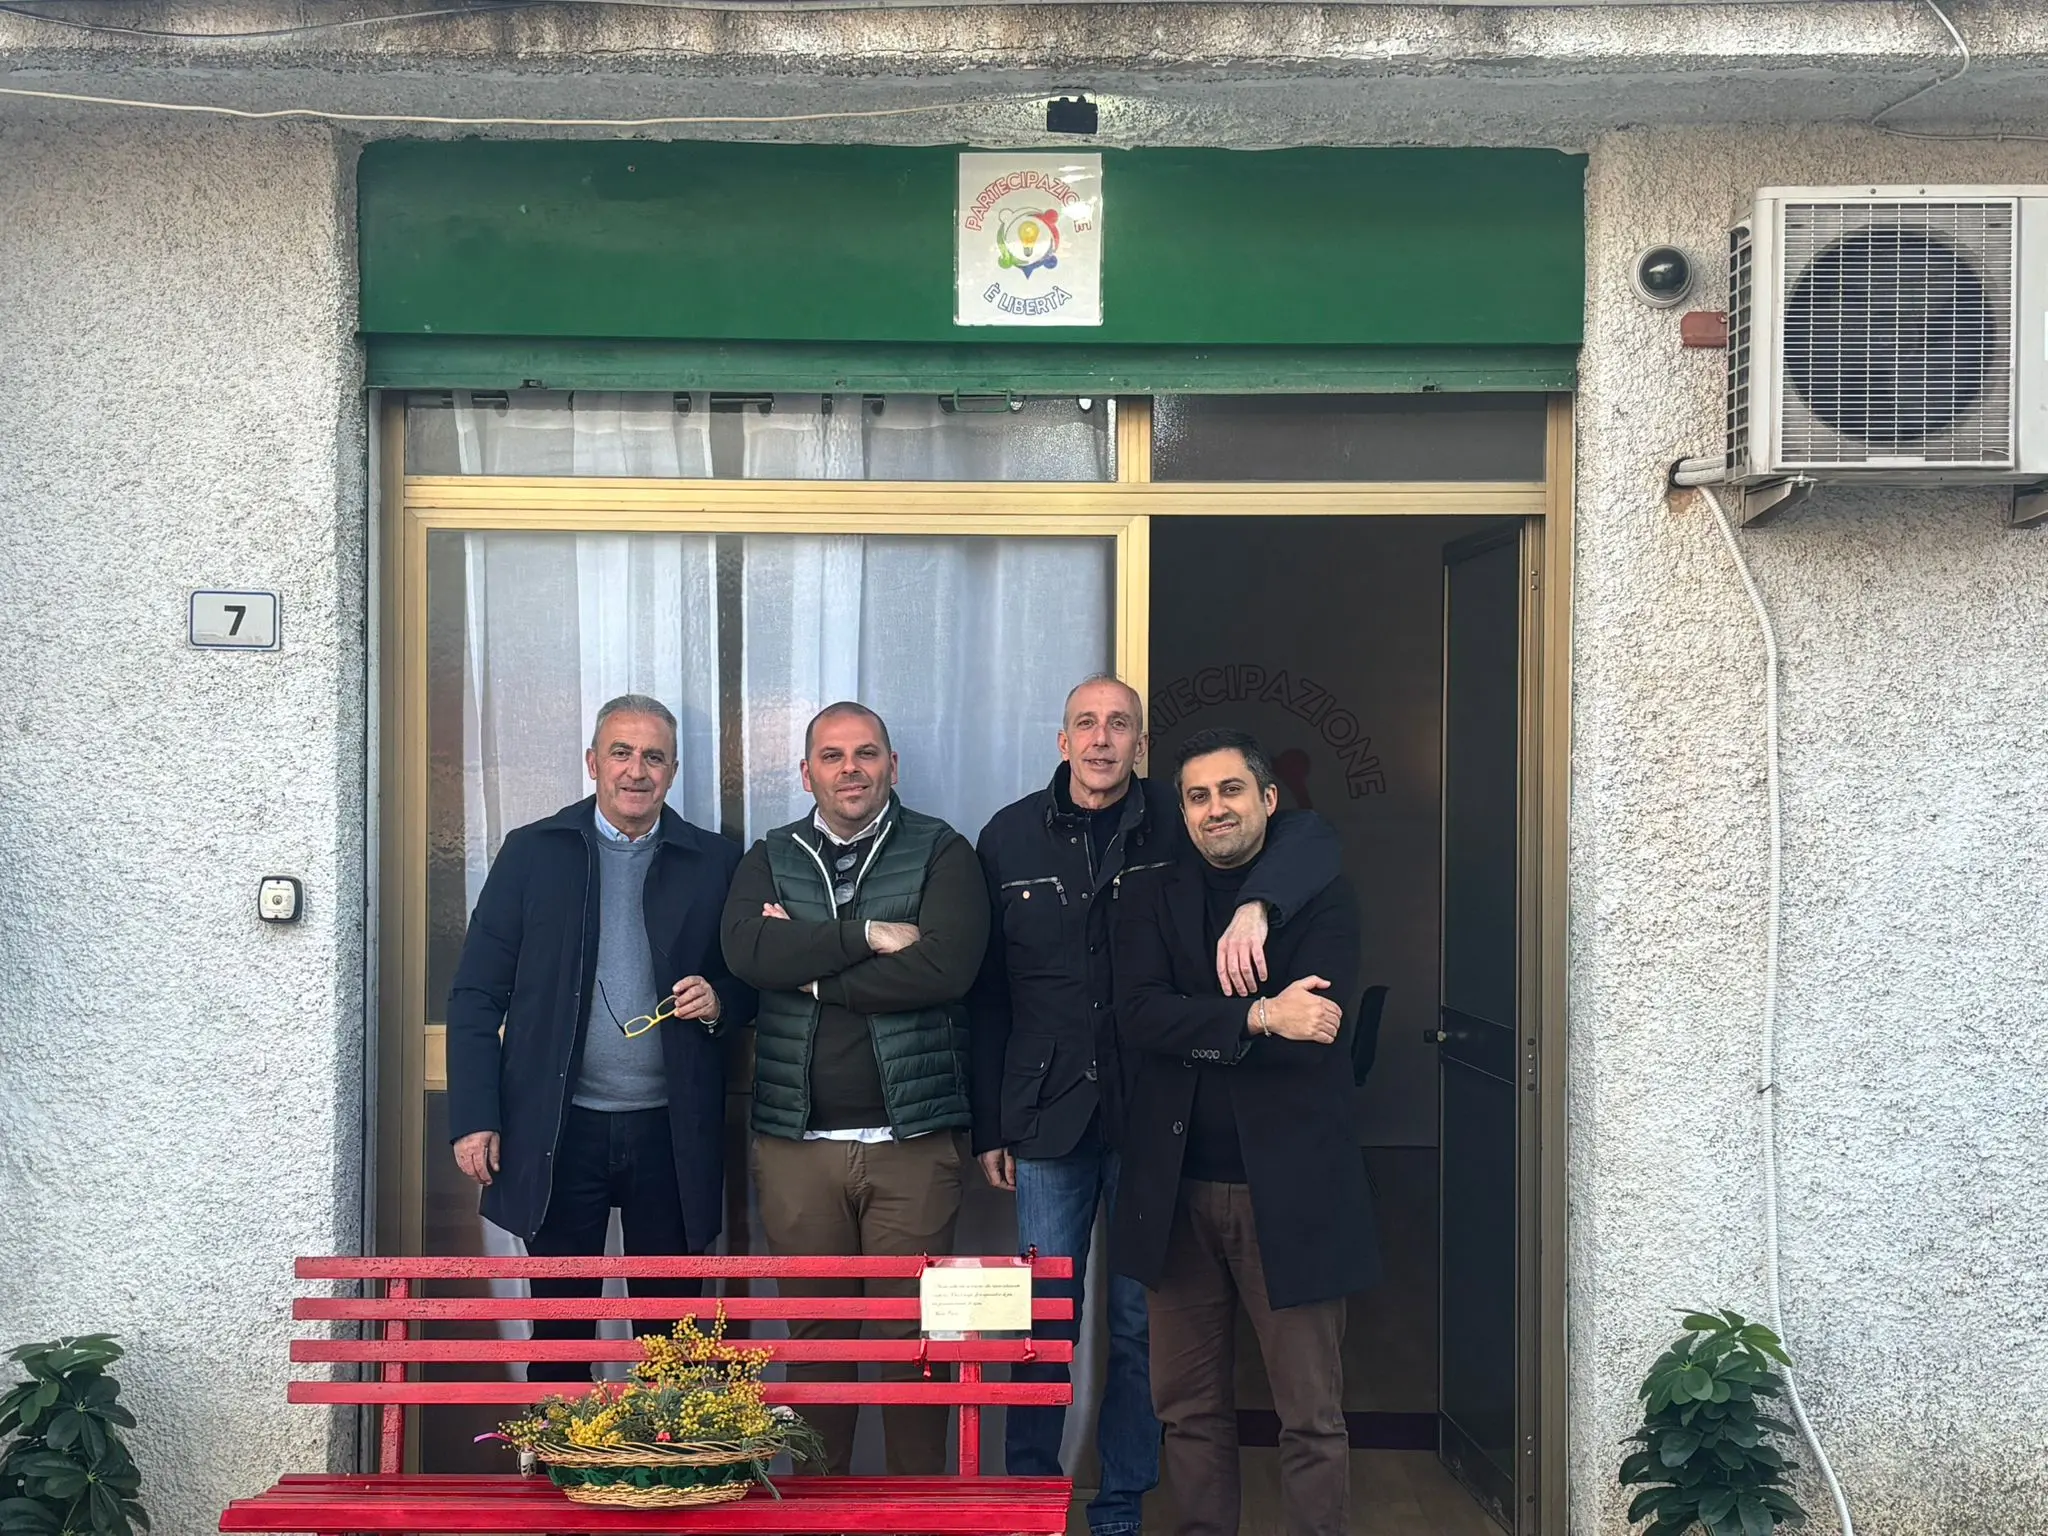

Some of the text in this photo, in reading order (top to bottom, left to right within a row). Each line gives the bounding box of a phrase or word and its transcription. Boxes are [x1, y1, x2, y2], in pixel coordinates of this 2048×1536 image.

[965, 171, 1092, 233] PARTECIPAZIOE
[998, 286, 1072, 315] LIBERTÀ
[224, 605, 246, 636] 7
